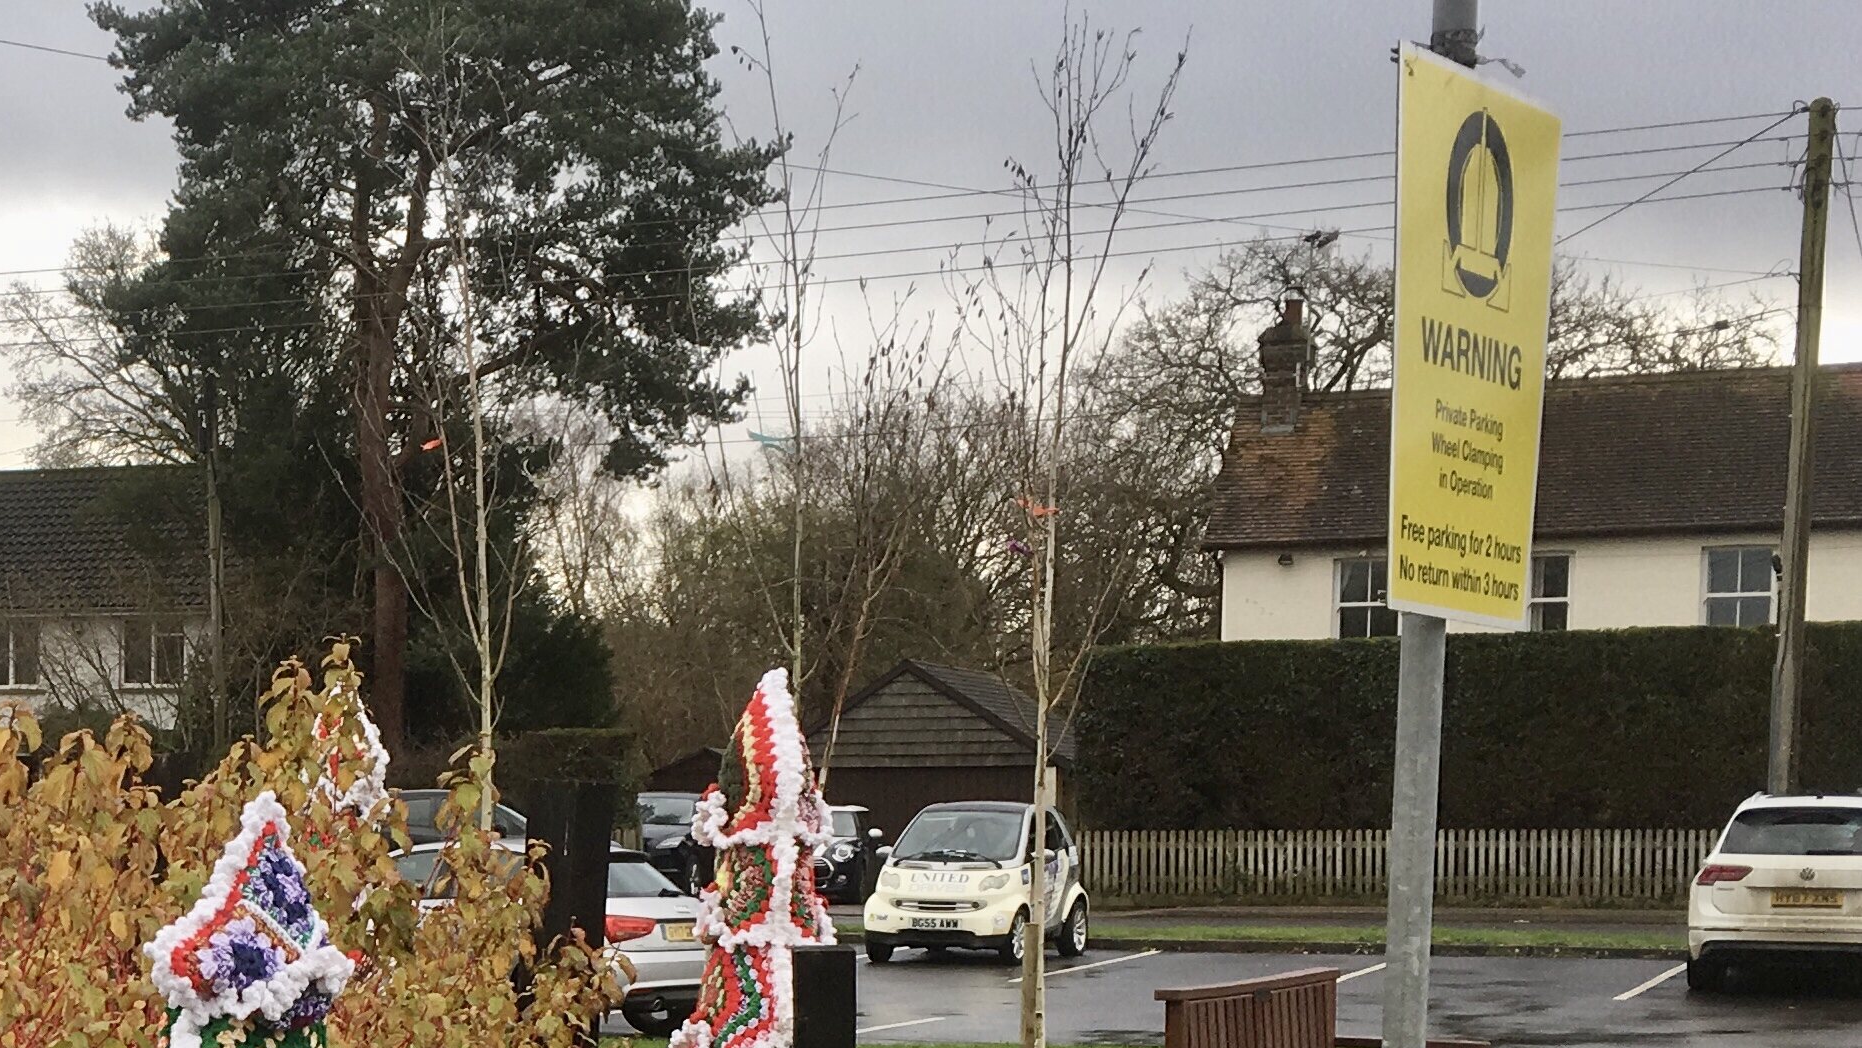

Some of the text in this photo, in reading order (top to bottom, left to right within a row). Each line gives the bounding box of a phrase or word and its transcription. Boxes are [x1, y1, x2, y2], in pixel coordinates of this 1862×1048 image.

[1421, 316, 1522, 391] WARNING
[1436, 398, 1503, 442] Private Parking
[1431, 431, 1503, 475] Wheel Clamping
[1439, 467, 1493, 500] in Operation
[1401, 514, 1521, 564] Free parking for 2 hours
[1399, 554, 1519, 601] No return within 3 hours
[910, 873, 970, 883] UNITED
